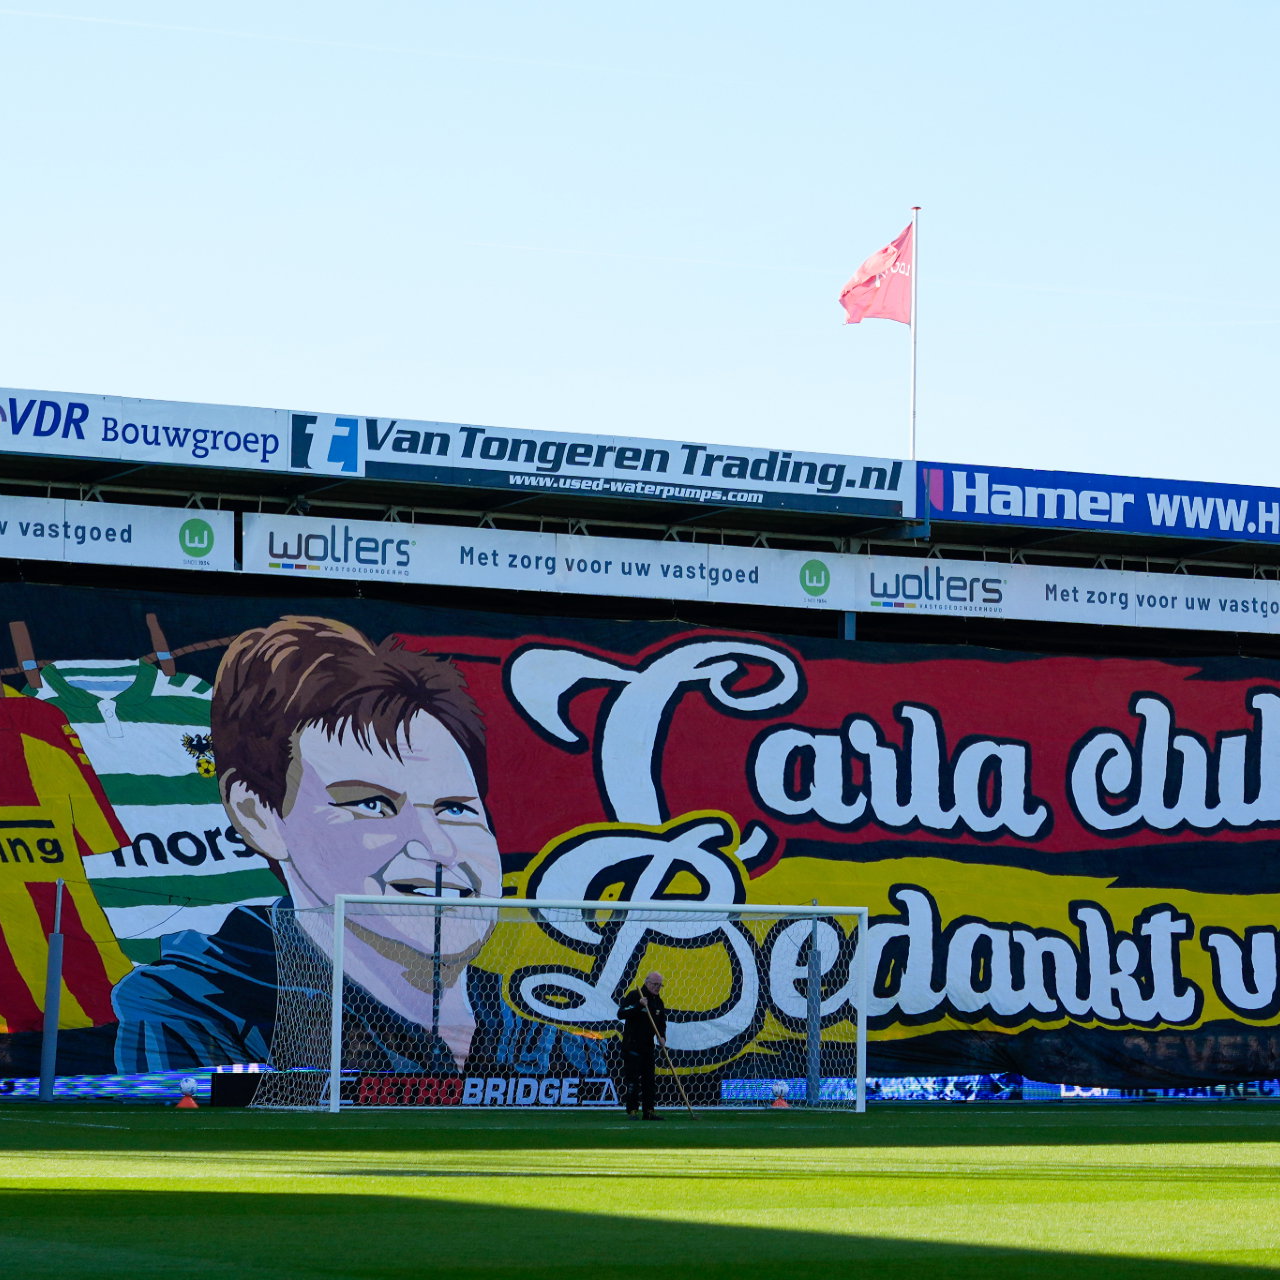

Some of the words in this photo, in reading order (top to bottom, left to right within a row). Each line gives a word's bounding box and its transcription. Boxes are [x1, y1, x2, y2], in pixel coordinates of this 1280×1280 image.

[8, 398, 89, 440] VDR
[102, 417, 279, 463] Bouwgroep
[365, 418, 450, 456] Van
[459, 426, 671, 473] Tongeren
[681, 444, 903, 494] Trading.nl
[509, 473, 763, 504] www.used-waterpumps.com
[952, 470, 1134, 523] Hamer
[19, 521, 132, 545] vastgoed
[269, 524, 410, 567] wolters
[460, 546, 499, 567] Met
[509, 552, 556, 575] zorg
[565, 557, 612, 575] voor
[621, 561, 650, 577] uw
[660, 563, 760, 586] vastgoed
[870, 566, 1003, 603] wolters
[1045, 583, 1078, 603] Met
[1087, 588, 1128, 609] zorg
[1137, 592, 1177, 610] voor
[1185, 595, 1210, 611] uw
[520, 823, 1197, 1051] Bedankt
